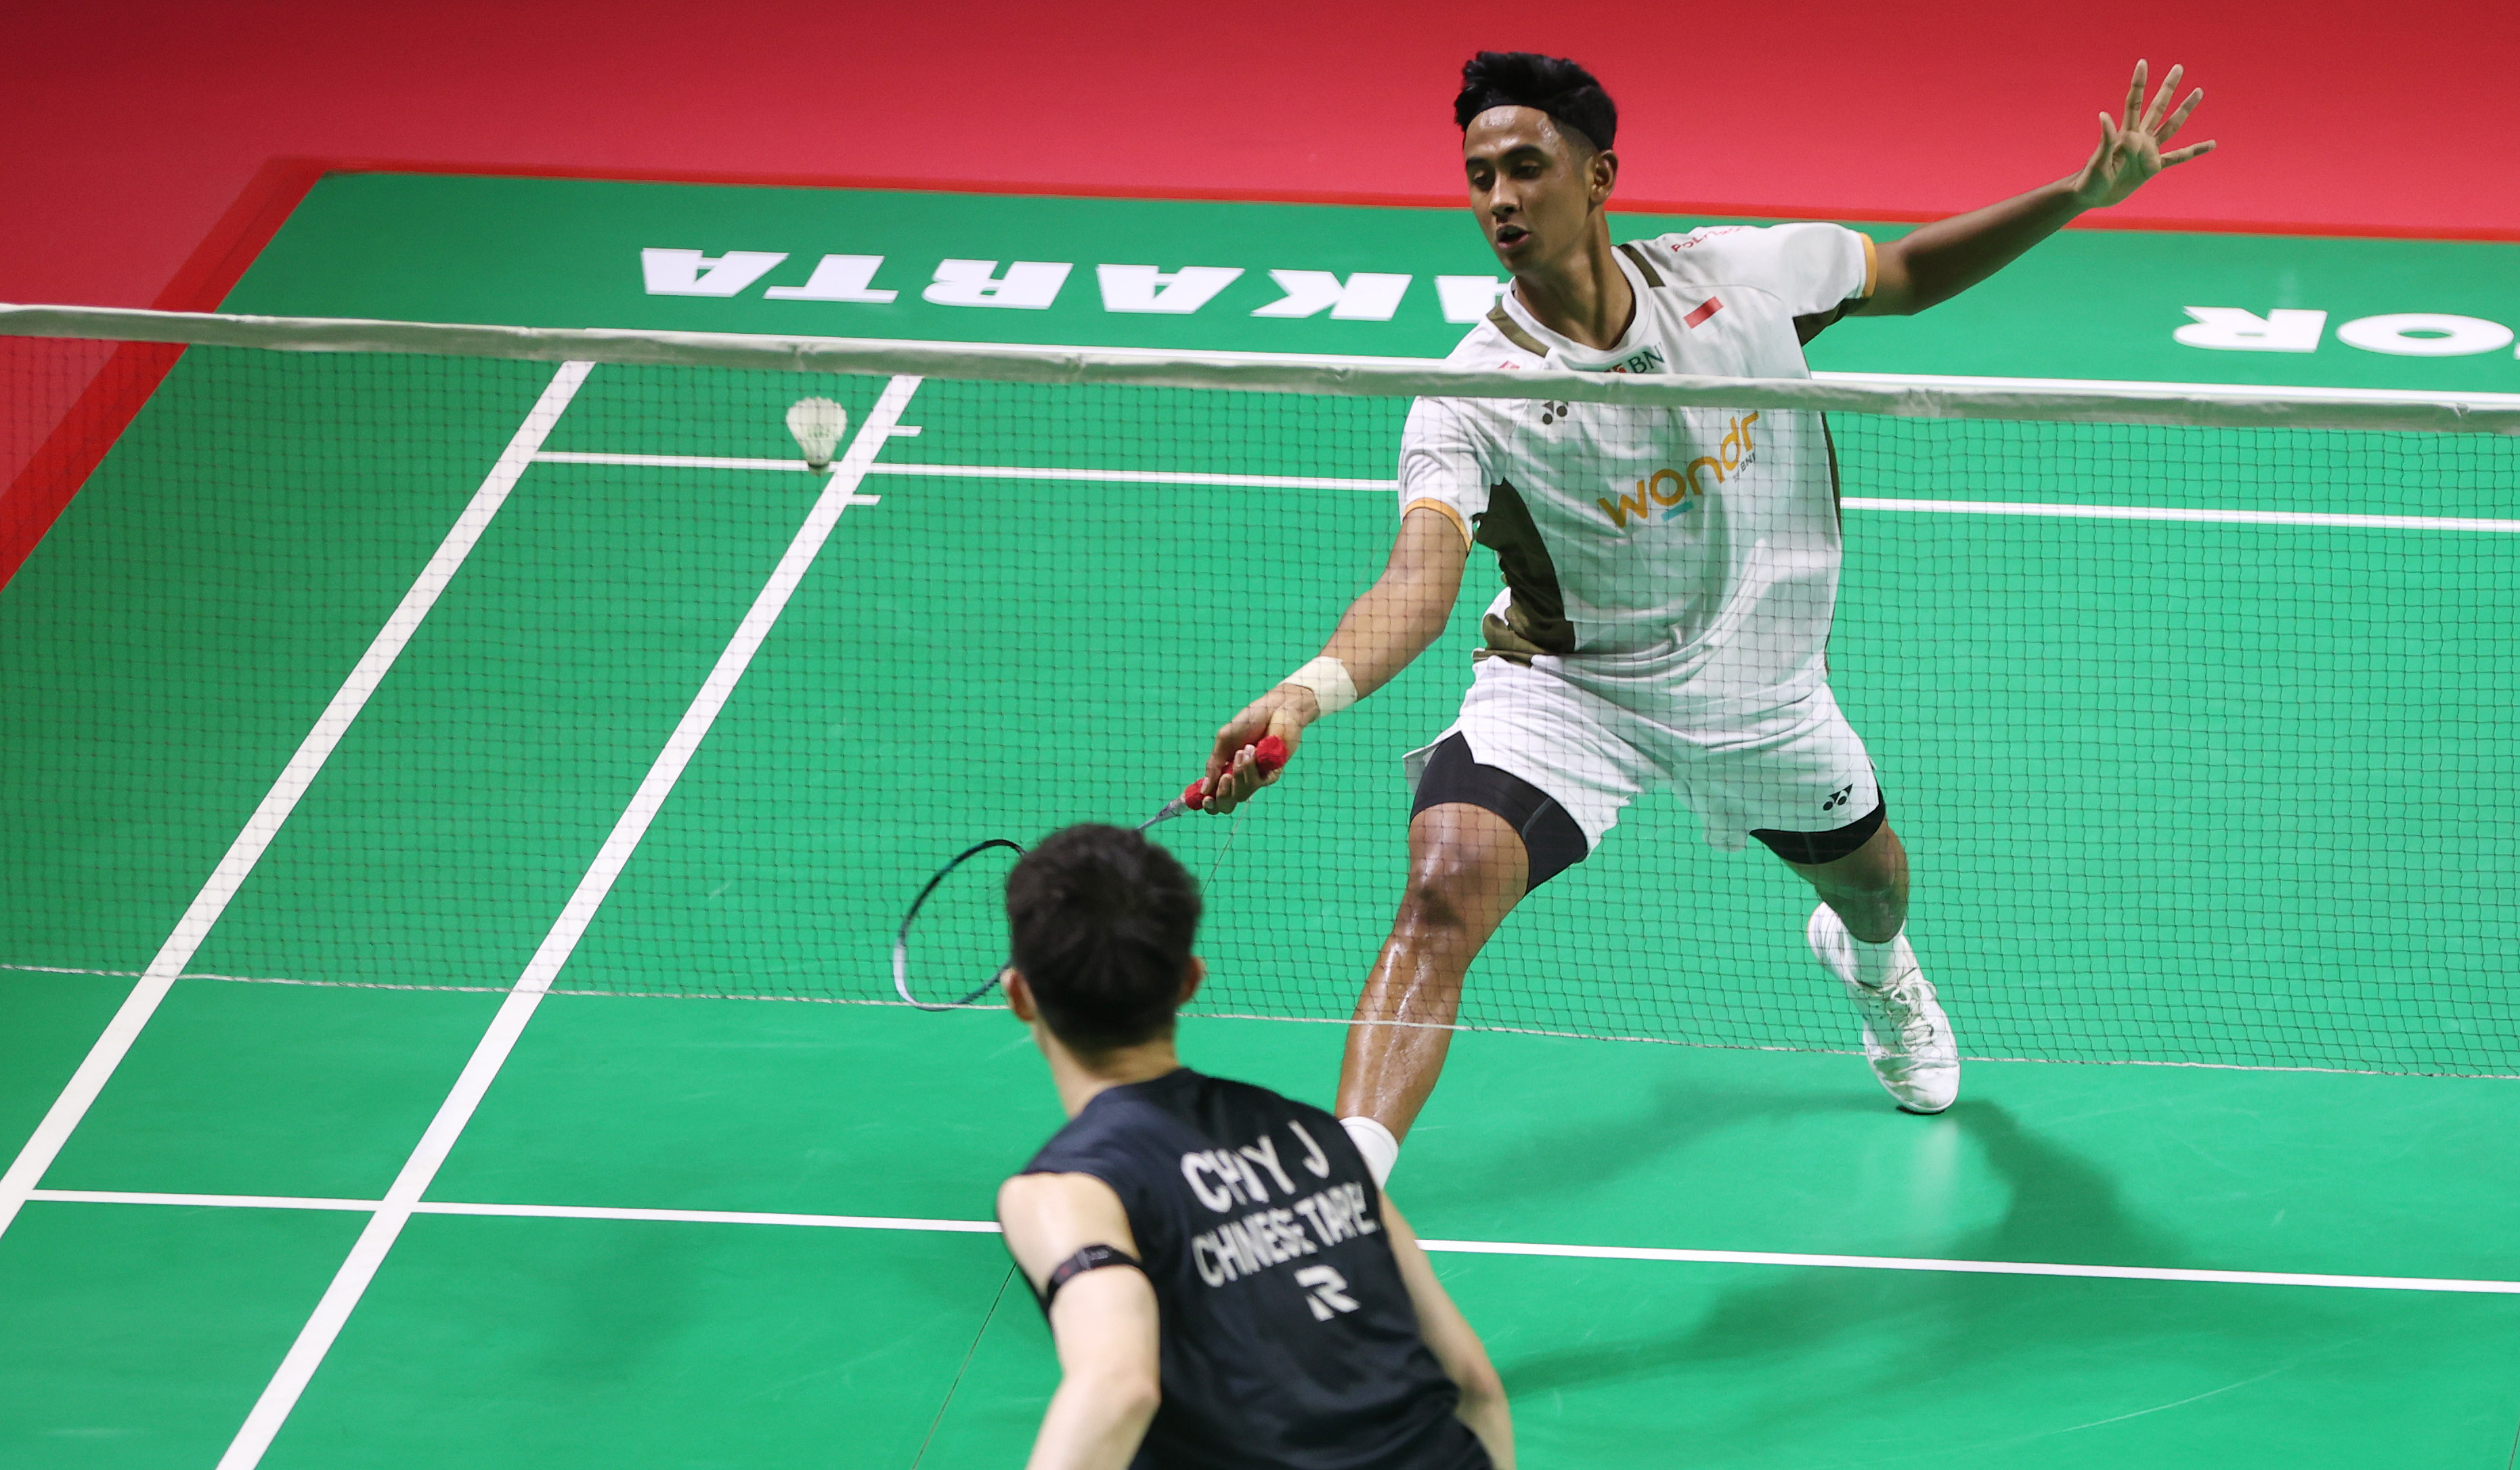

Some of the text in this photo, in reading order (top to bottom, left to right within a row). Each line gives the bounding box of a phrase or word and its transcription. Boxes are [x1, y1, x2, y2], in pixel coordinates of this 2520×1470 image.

[640, 246, 1510, 324] AKARTA
[2173, 305, 2520, 360] OR
[1596, 412, 1759, 528] wondr
[1239, 1135, 1297, 1195] Y
[1288, 1119, 1330, 1179] J
